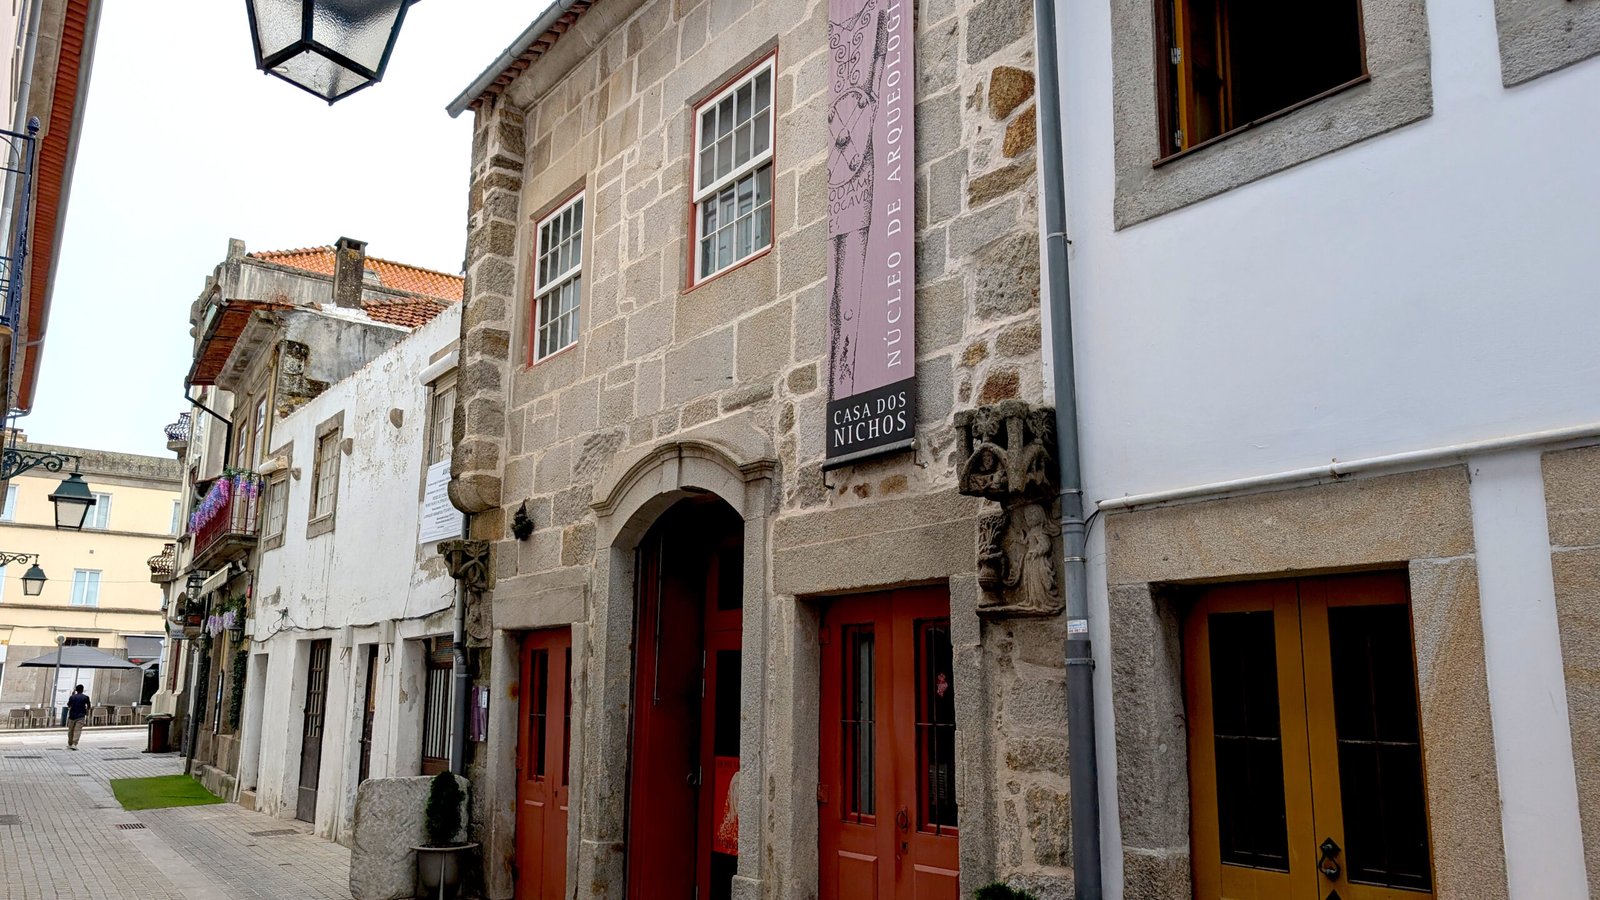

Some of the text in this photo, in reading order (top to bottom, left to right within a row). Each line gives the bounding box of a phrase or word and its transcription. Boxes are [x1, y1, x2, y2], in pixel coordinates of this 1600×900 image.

[887, 198, 902, 237] DE
[883, 251, 902, 368] NÚCLEO
[833, 391, 906, 426] CASA DOS
[834, 410, 907, 448] NICHOS
